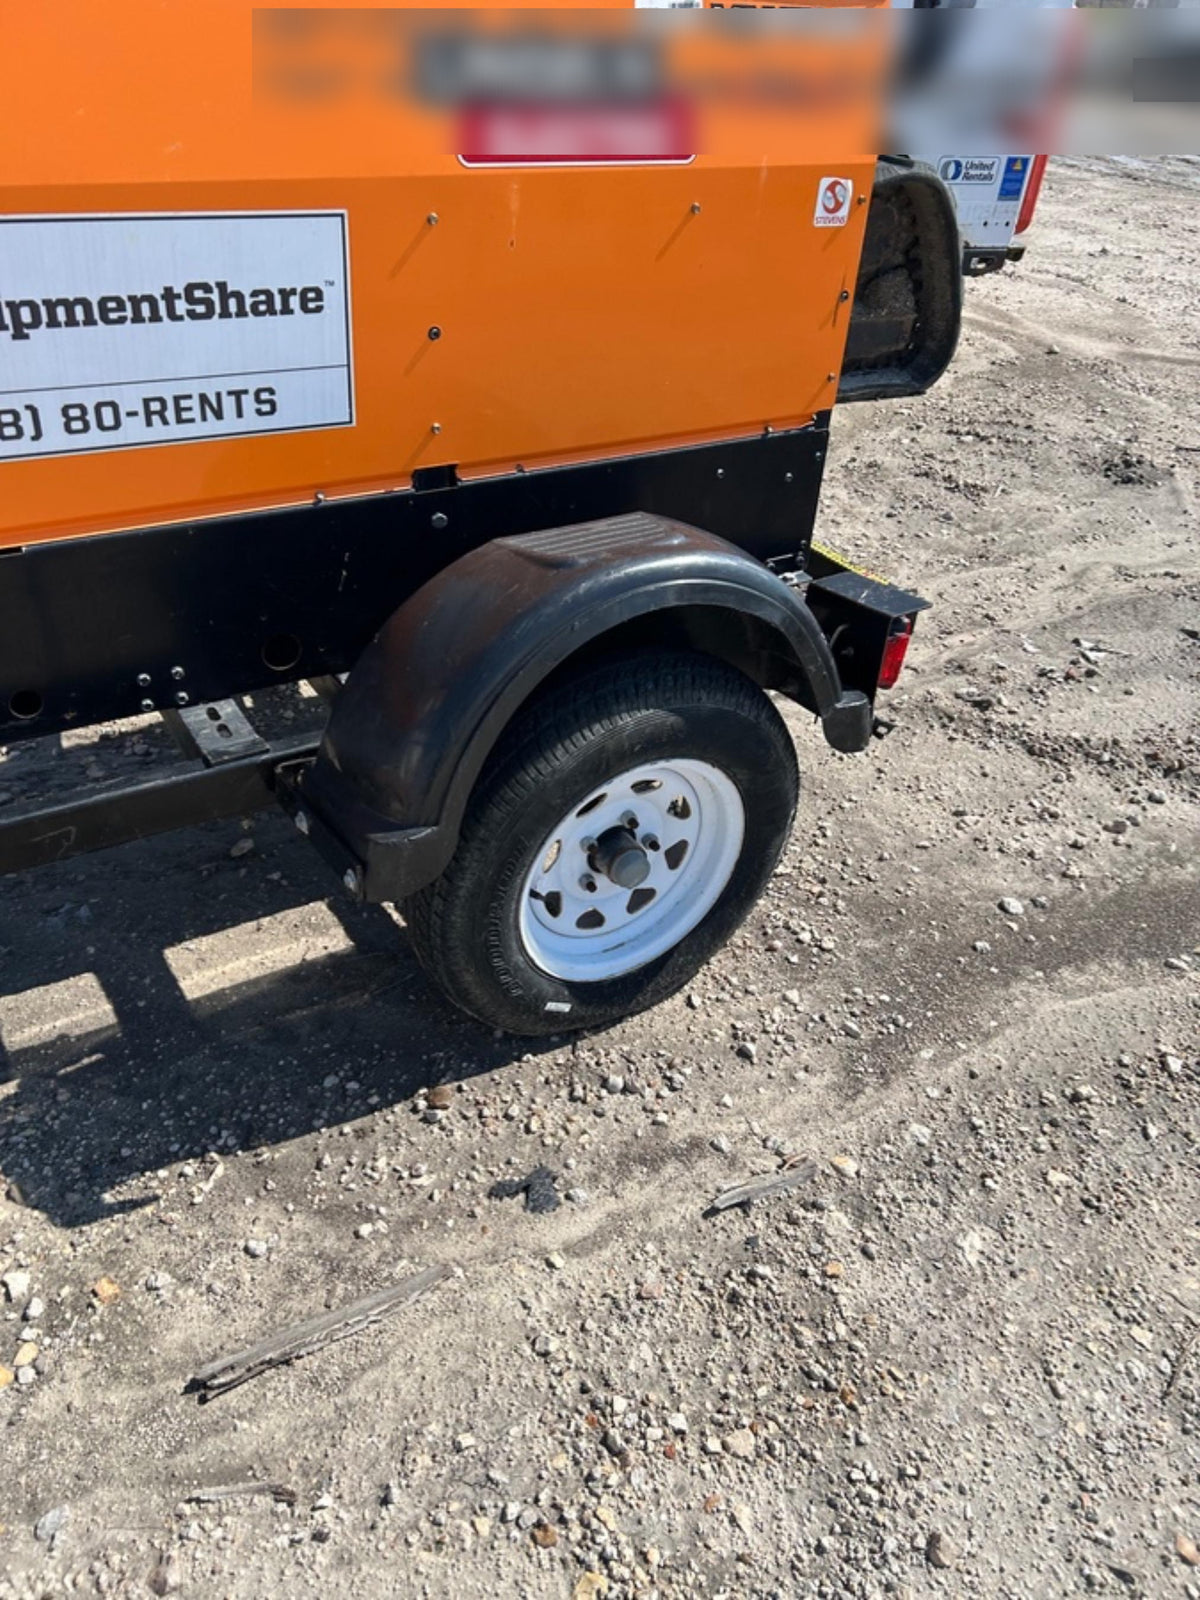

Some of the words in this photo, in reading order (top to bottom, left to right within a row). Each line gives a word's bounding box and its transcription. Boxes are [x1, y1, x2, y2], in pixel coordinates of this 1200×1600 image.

[965, 160, 995, 171] United
[962, 171, 994, 181] Rentals
[61, 386, 278, 436] 80-RENTS
